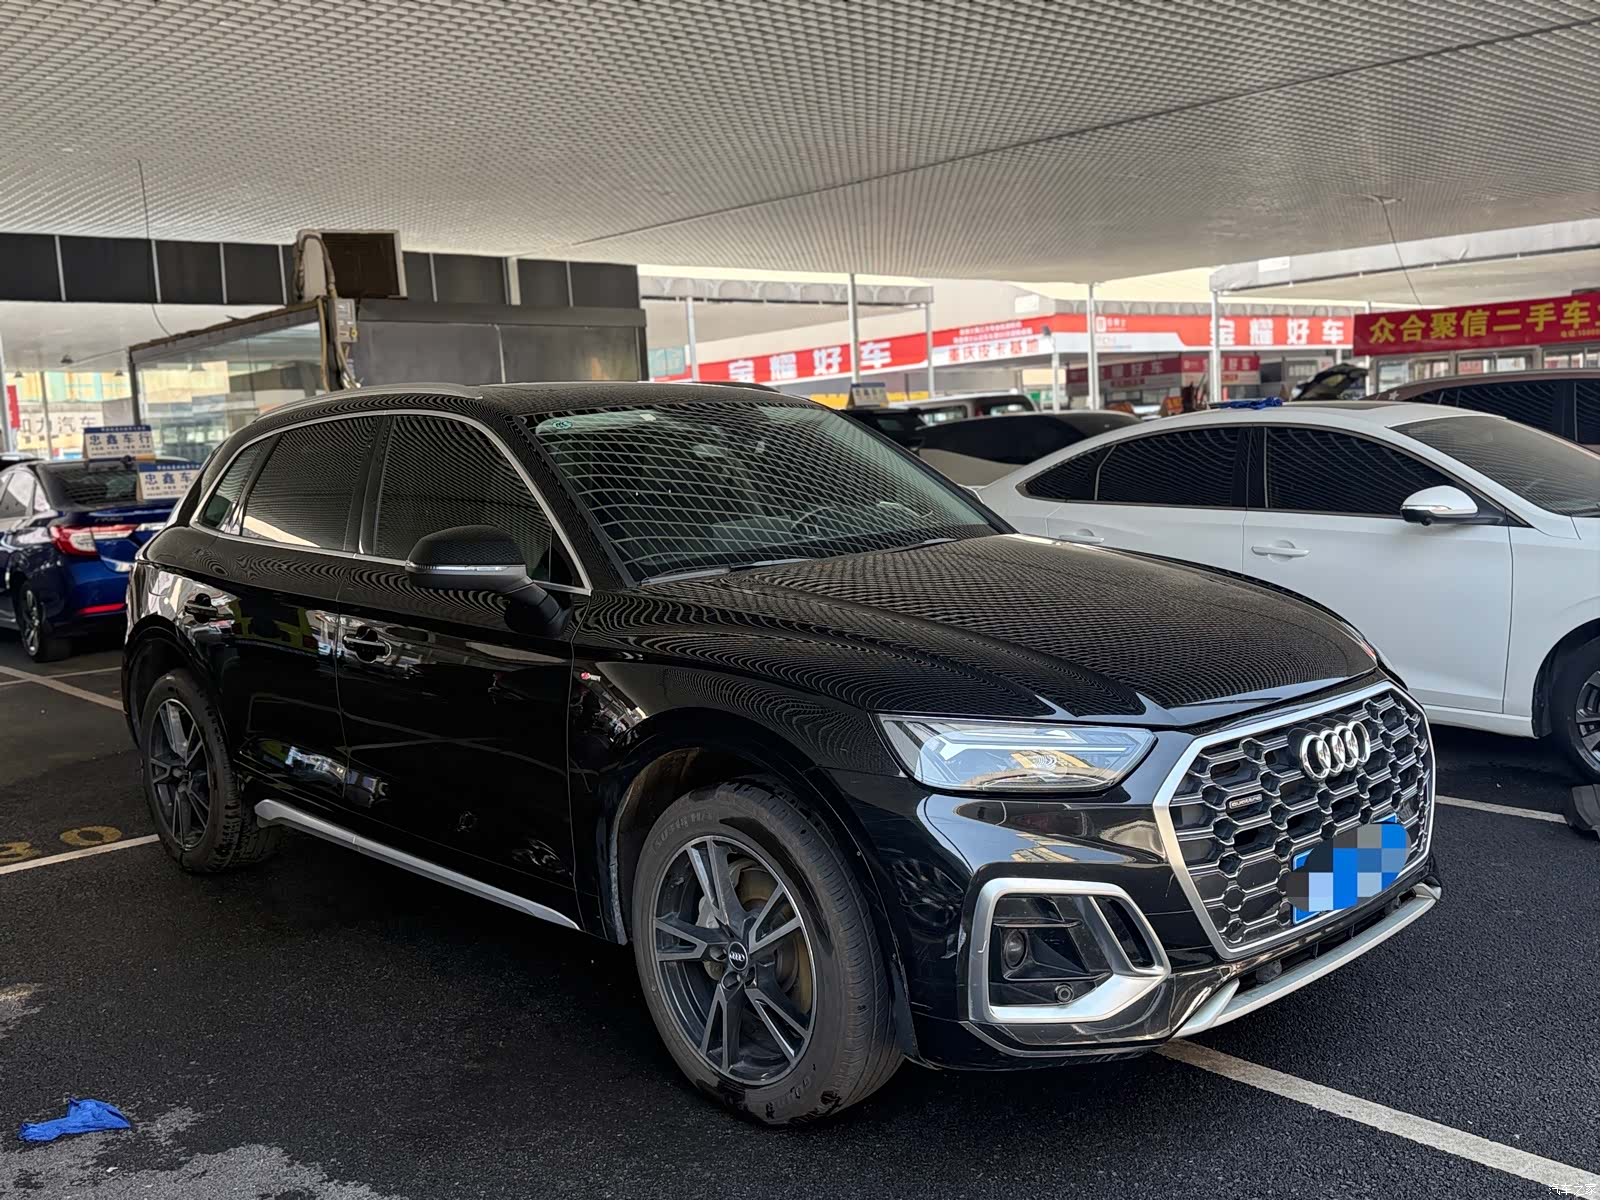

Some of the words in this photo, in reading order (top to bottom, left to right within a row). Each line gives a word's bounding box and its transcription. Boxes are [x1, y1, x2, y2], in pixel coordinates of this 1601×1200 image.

[1210, 318, 1345, 346] 宝耀好车
[1369, 300, 1600, 344] 众合聚信二手车
[729, 341, 892, 383] 宝耀好车
[89, 432, 151, 446] 忠鑫车行
